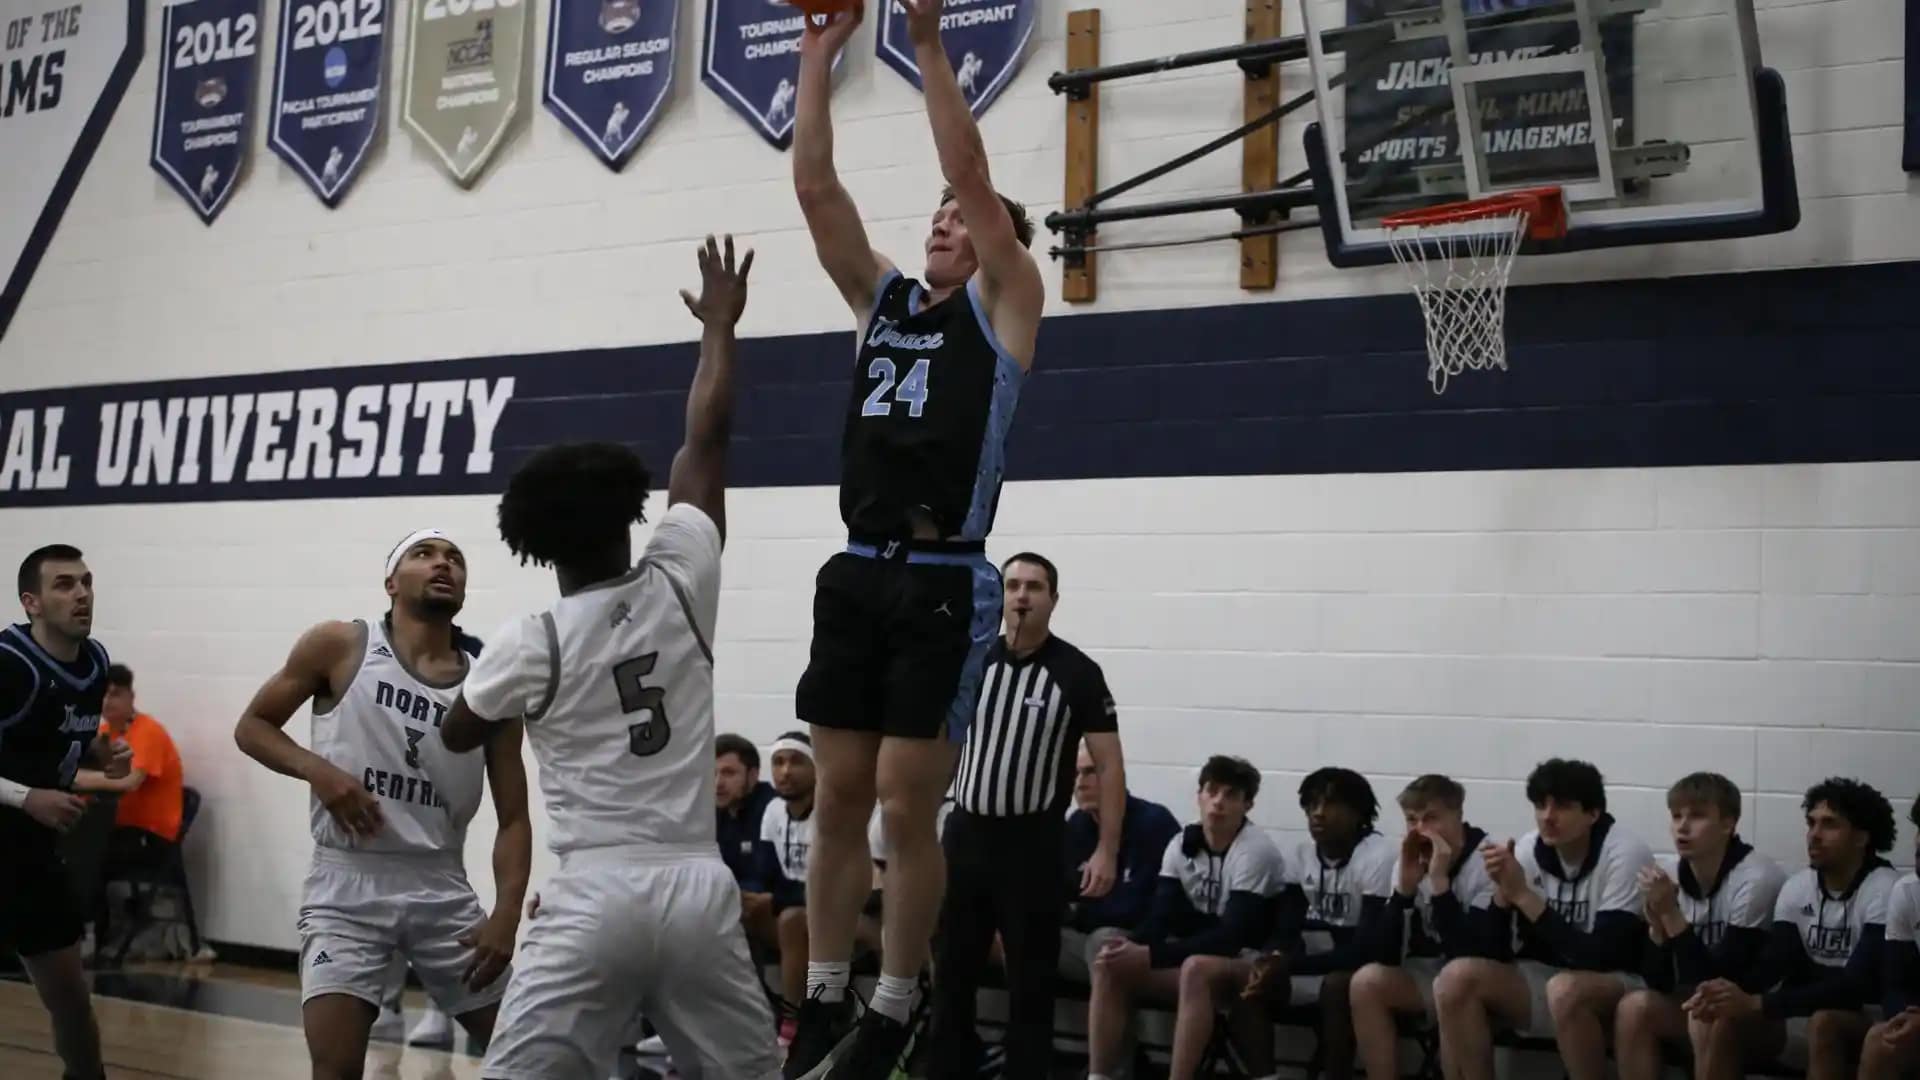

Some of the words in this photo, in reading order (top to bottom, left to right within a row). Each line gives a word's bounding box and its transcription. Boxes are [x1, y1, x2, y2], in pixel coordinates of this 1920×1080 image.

[6, 16, 33, 51] OF
[41, 4, 82, 43] THE
[293, 0, 382, 50] 2012
[739, 14, 828, 39] TOURNAMNT
[939, 4, 1016, 31] RTICIPANT
[174, 12, 257, 69] 2012
[565, 45, 621, 67] REGULAR
[623, 37, 670, 58] SEASON
[0, 49, 66, 118] MS
[583, 60, 653, 84] CHAMPIONS
[301, 108, 367, 130] PARTICIPANT
[436, 87, 499, 111] CHAMPIONS
[181, 112, 244, 134] TOURNAMENT
[184, 131, 239, 152] CHAMPIONS
[862, 357, 931, 417] 24
[0, 406, 71, 491] AL
[96, 376, 516, 488] UNIVERSITY
[376, 681, 448, 728] NORT
[612, 651, 671, 757] 5
[404, 725, 425, 770] 3
